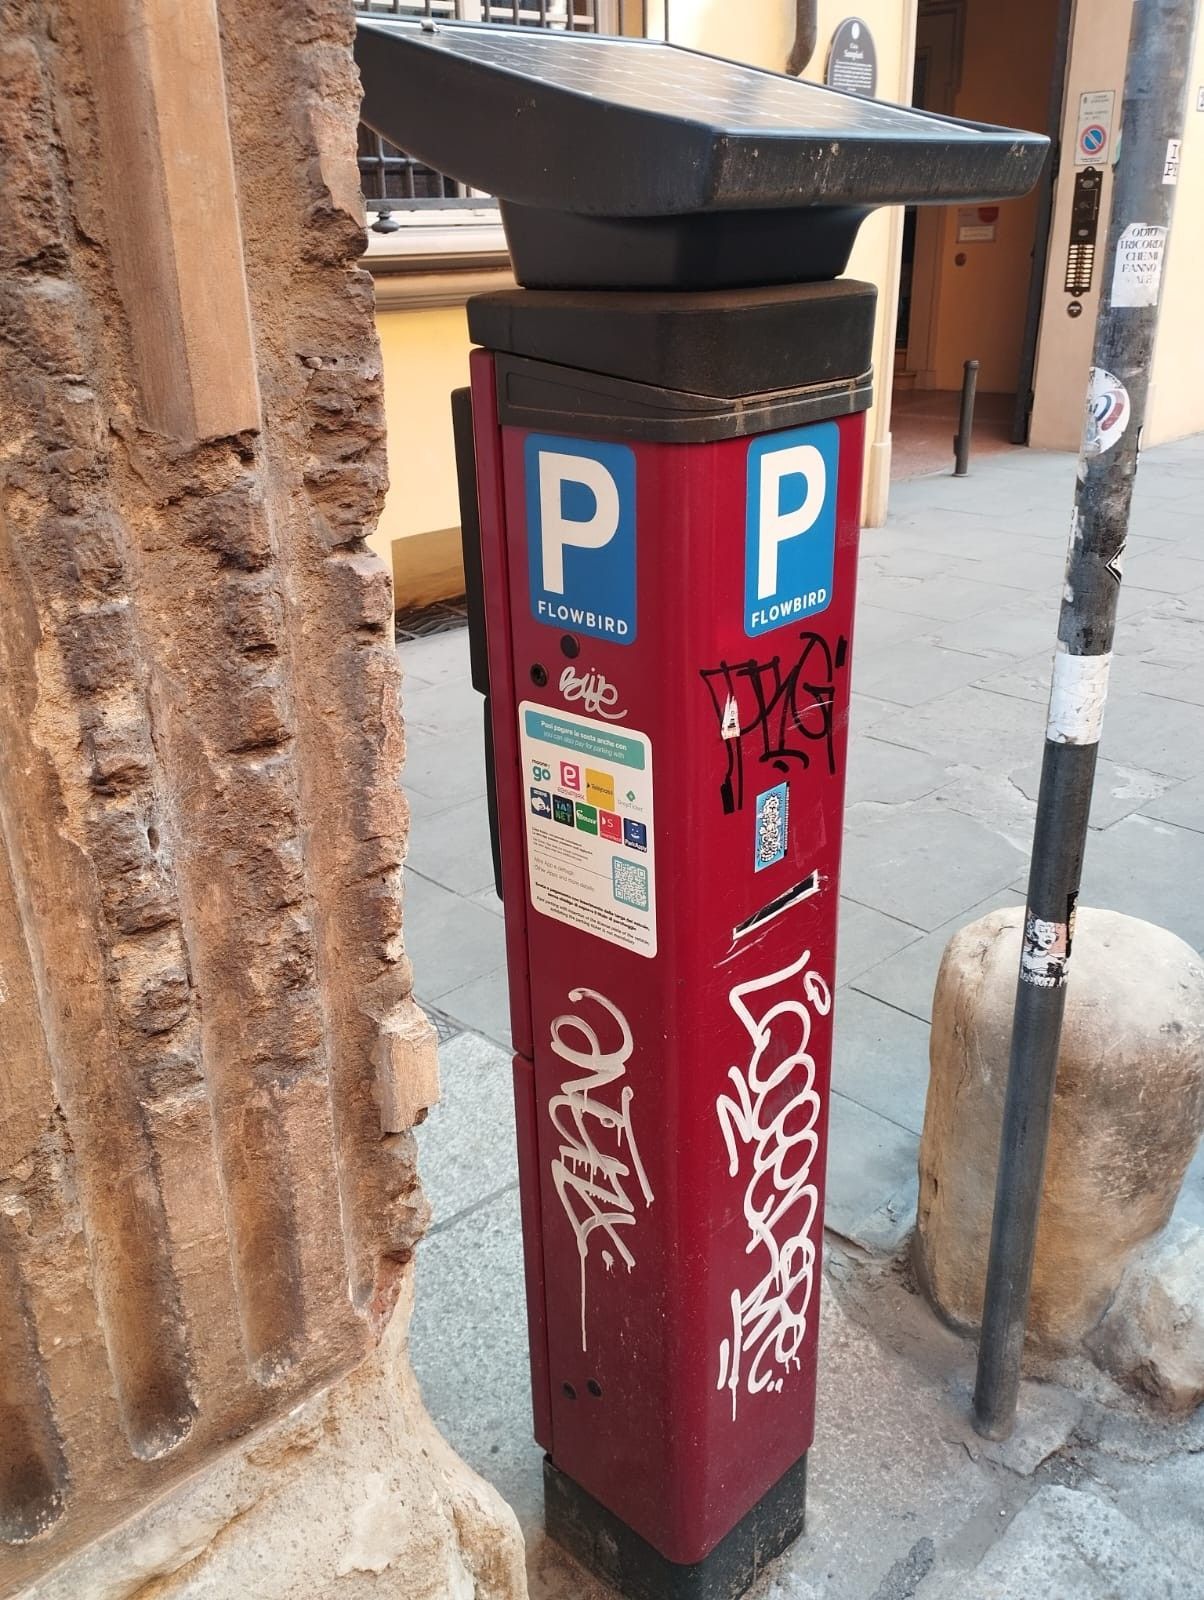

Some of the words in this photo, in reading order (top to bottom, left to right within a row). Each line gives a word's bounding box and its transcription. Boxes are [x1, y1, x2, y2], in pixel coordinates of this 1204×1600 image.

[538, 450, 619, 595] P
[757, 444, 826, 600] P
[538, 600, 628, 635] FLOWBIRD
[751, 588, 827, 628] FLOWBIRD
[533, 765, 551, 784] go
